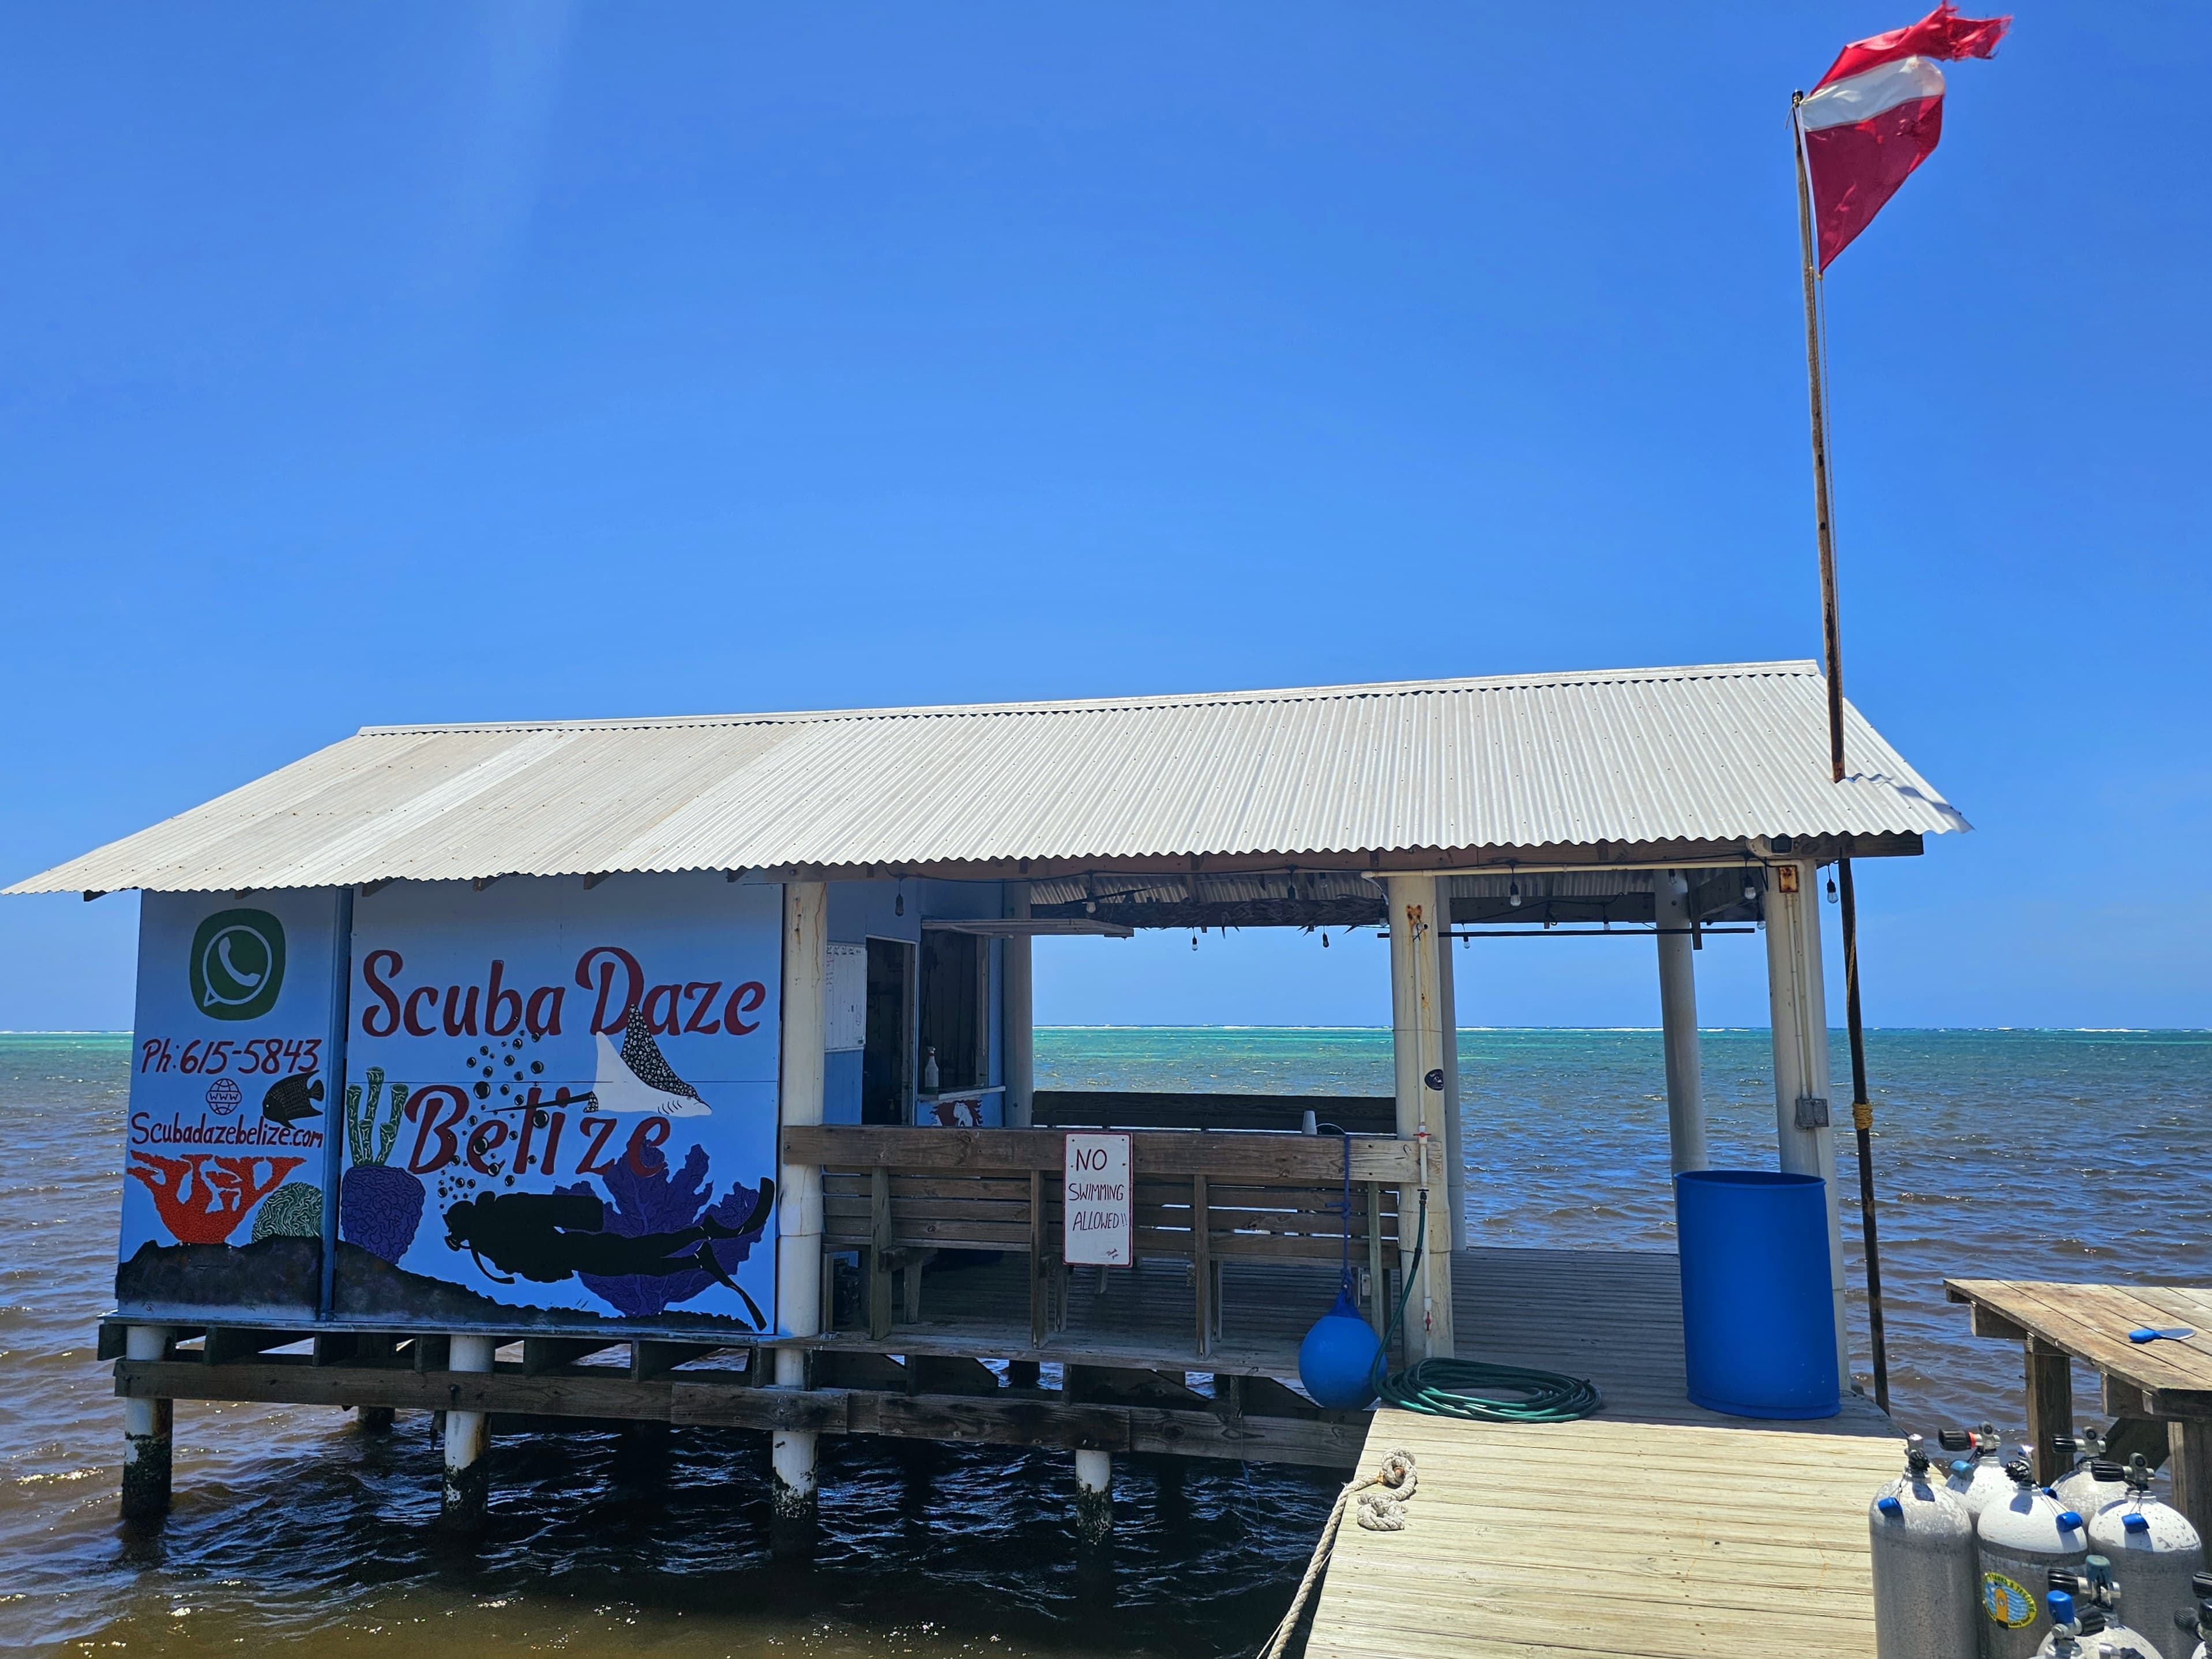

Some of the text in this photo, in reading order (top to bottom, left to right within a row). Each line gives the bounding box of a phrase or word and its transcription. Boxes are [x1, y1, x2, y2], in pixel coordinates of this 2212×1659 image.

[362, 946, 767, 1037] Scuba Daze
[131, 1111, 324, 1148] Scubadazebelize.com
[404, 1084, 671, 1178] Belize
[1076, 1149, 1107, 1171] NO
[1068, 1183, 1124, 1201] SWIMMING
